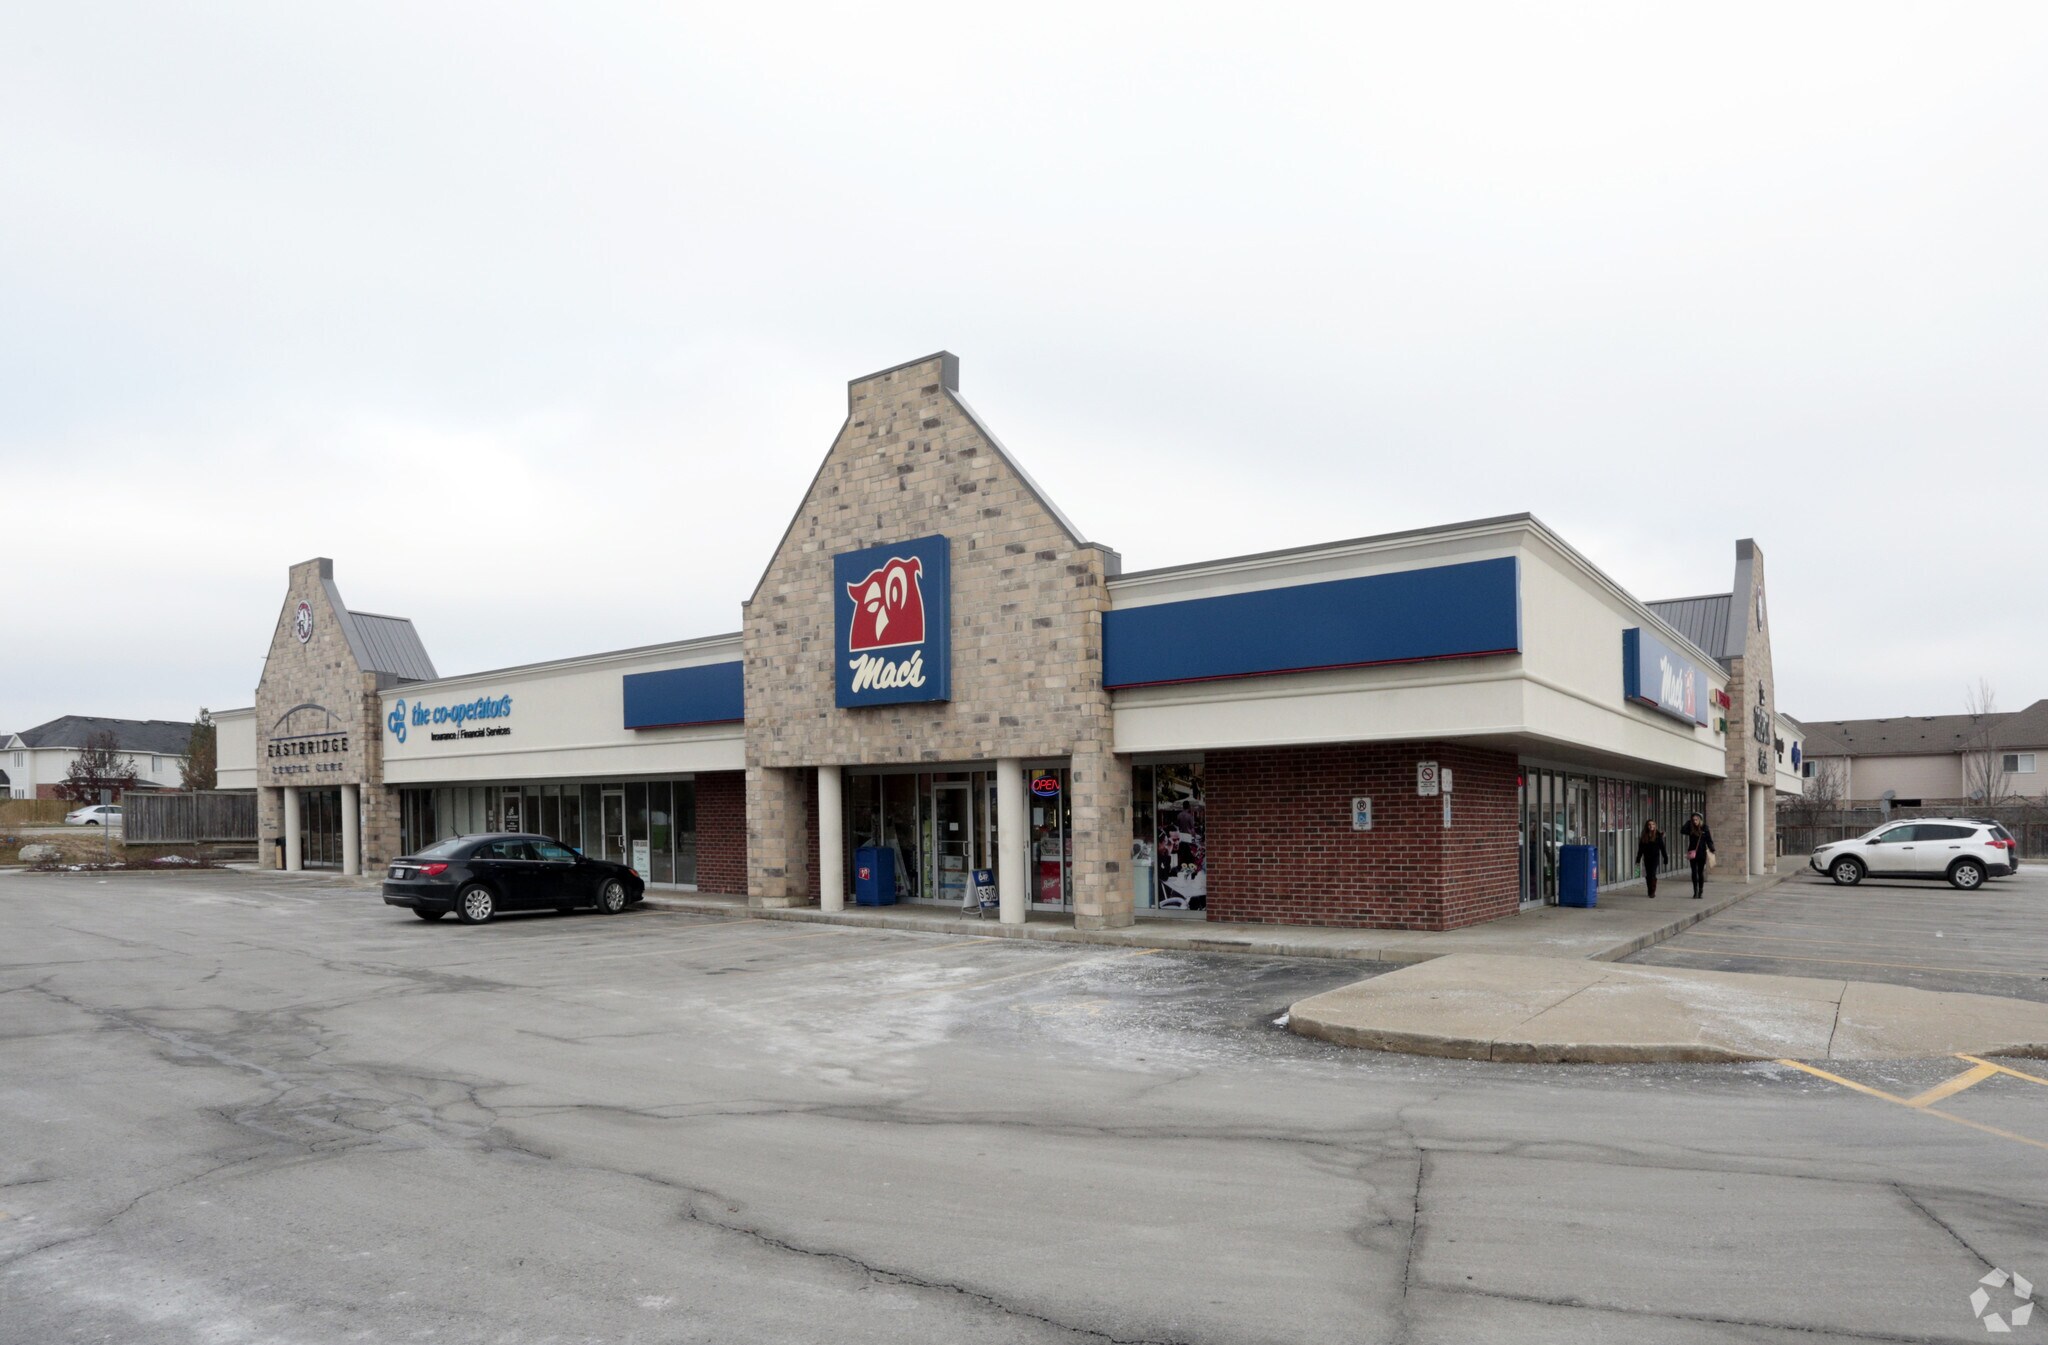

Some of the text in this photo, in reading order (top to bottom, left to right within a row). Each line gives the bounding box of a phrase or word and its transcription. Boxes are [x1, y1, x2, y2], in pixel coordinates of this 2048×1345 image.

[849, 649, 926, 693] Mac's
[1660, 655, 1684, 712] Mac's
[412, 694, 511, 728] the co-operators
[431, 731, 456, 741] Insurance
[460, 727, 485, 739] Financial
[486, 725, 511, 737] Services
[267, 737, 349, 758] EASTBRIDGE
[1033, 779, 1060, 791] OPEN
